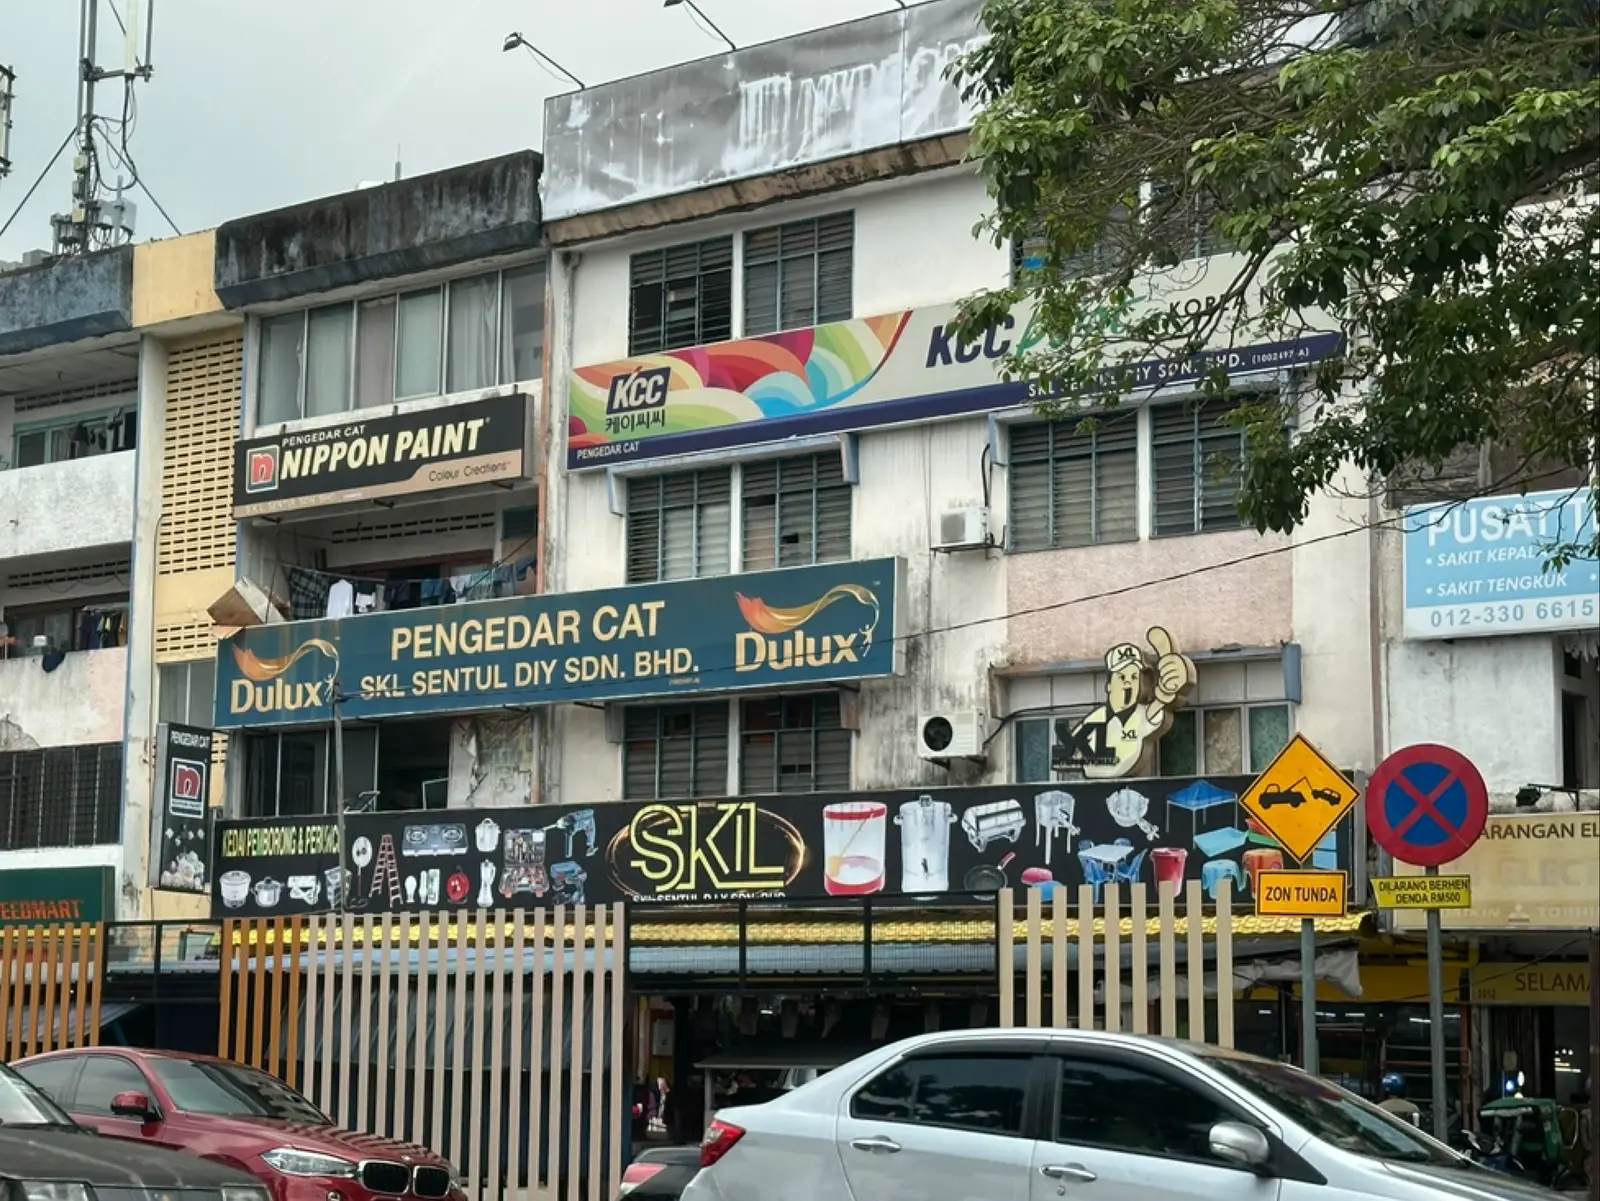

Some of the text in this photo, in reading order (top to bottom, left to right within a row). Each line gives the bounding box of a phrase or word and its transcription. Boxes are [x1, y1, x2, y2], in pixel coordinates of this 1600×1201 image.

[926, 314, 1015, 368] KCC
[612, 371, 665, 410] KCC
[281, 424, 366, 447] PENGEDAR CAT
[281, 418, 484, 480] NIPPON PAINT
[577, 441, 640, 460] PENGEDAR CAT
[428, 469, 460, 482] Colour
[1428, 500, 1555, 547] PUSAT
[1437, 550, 1483, 567] SAKIT
[1437, 573, 1567, 597] SAKIT TENGKUK
[1430, 599, 1594, 628] 012-330 6615
[391, 600, 665, 660] PENGEDAR CAT
[735, 629, 859, 672] Dulux
[360, 648, 699, 699] SKL SENTUL DIY SDN. BHD.
[231, 679, 322, 714] Dulux
[1480, 822, 1597, 840] ARANGAN EL
[631, 802, 784, 892] SKL
[1265, 886, 1338, 902] ZON TUNDA
[1378, 879, 1470, 891] DILARANG BERHEN
[1395, 893, 1429, 904] DENDA
